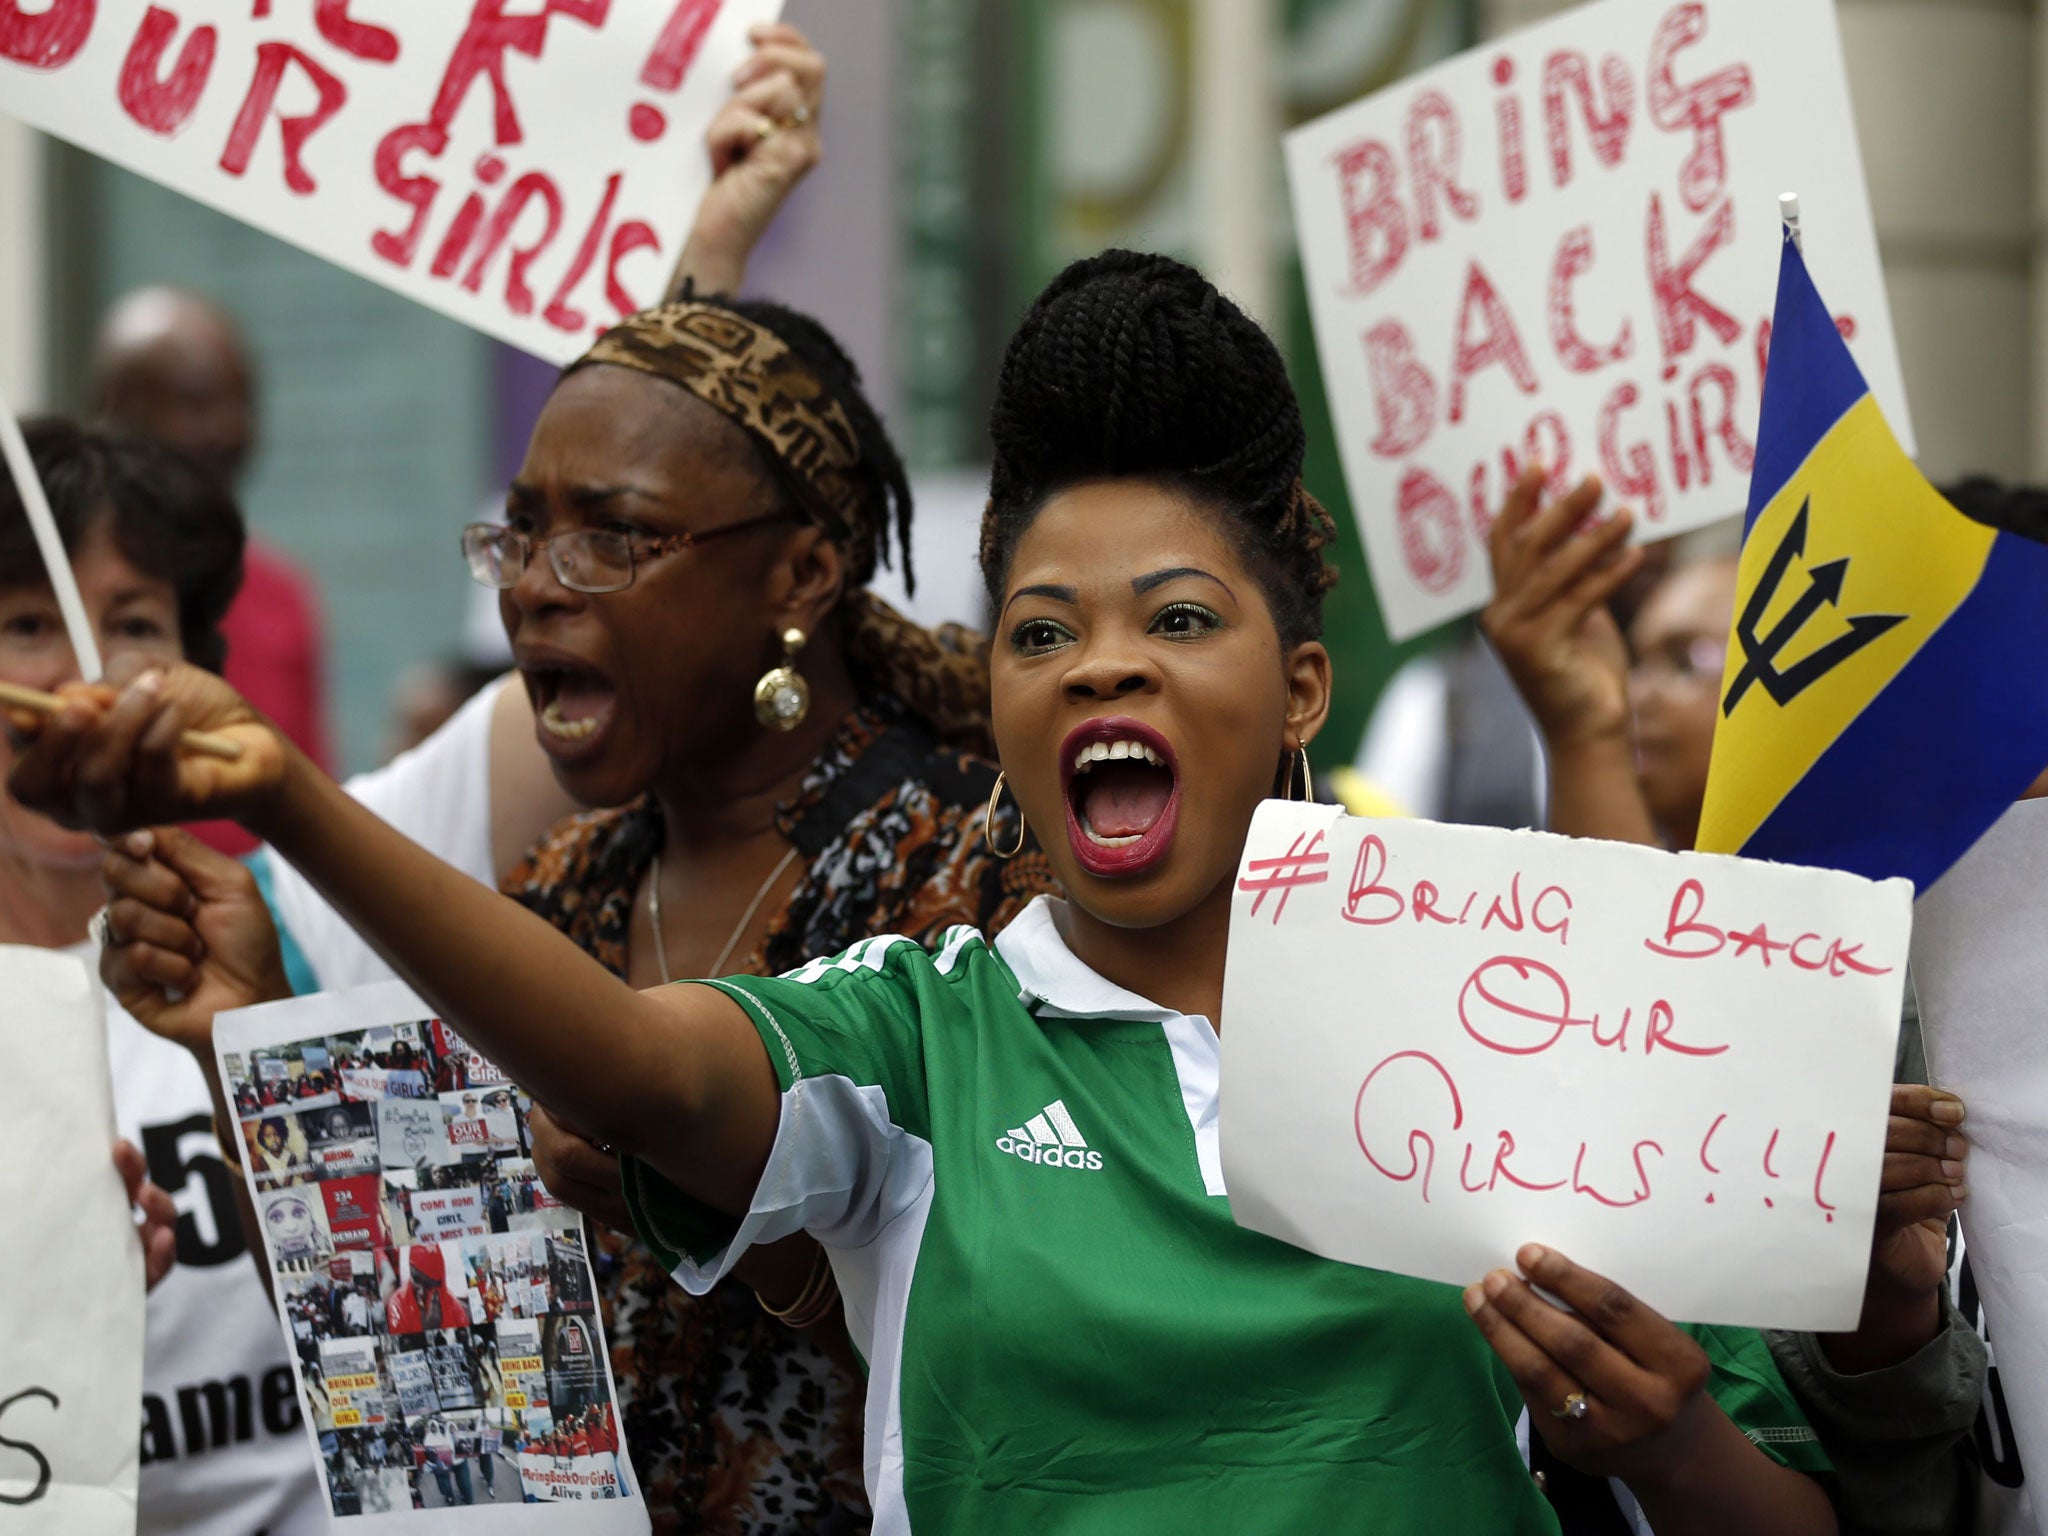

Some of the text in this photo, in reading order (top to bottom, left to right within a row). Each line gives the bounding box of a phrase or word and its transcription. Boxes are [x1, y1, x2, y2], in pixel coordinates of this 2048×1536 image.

[1361, 191, 1745, 458] BACK
[1645, 878, 1893, 977] BACK
[1458, 954, 1730, 1056] OUR
[453, 1121, 482, 1137] OUR
[996, 1137, 1103, 1170] adidas
[328, 1375, 376, 1390] BRING BACK
[332, 1396, 349, 1407] OUR
[550, 1486, 583, 1500] Alive
